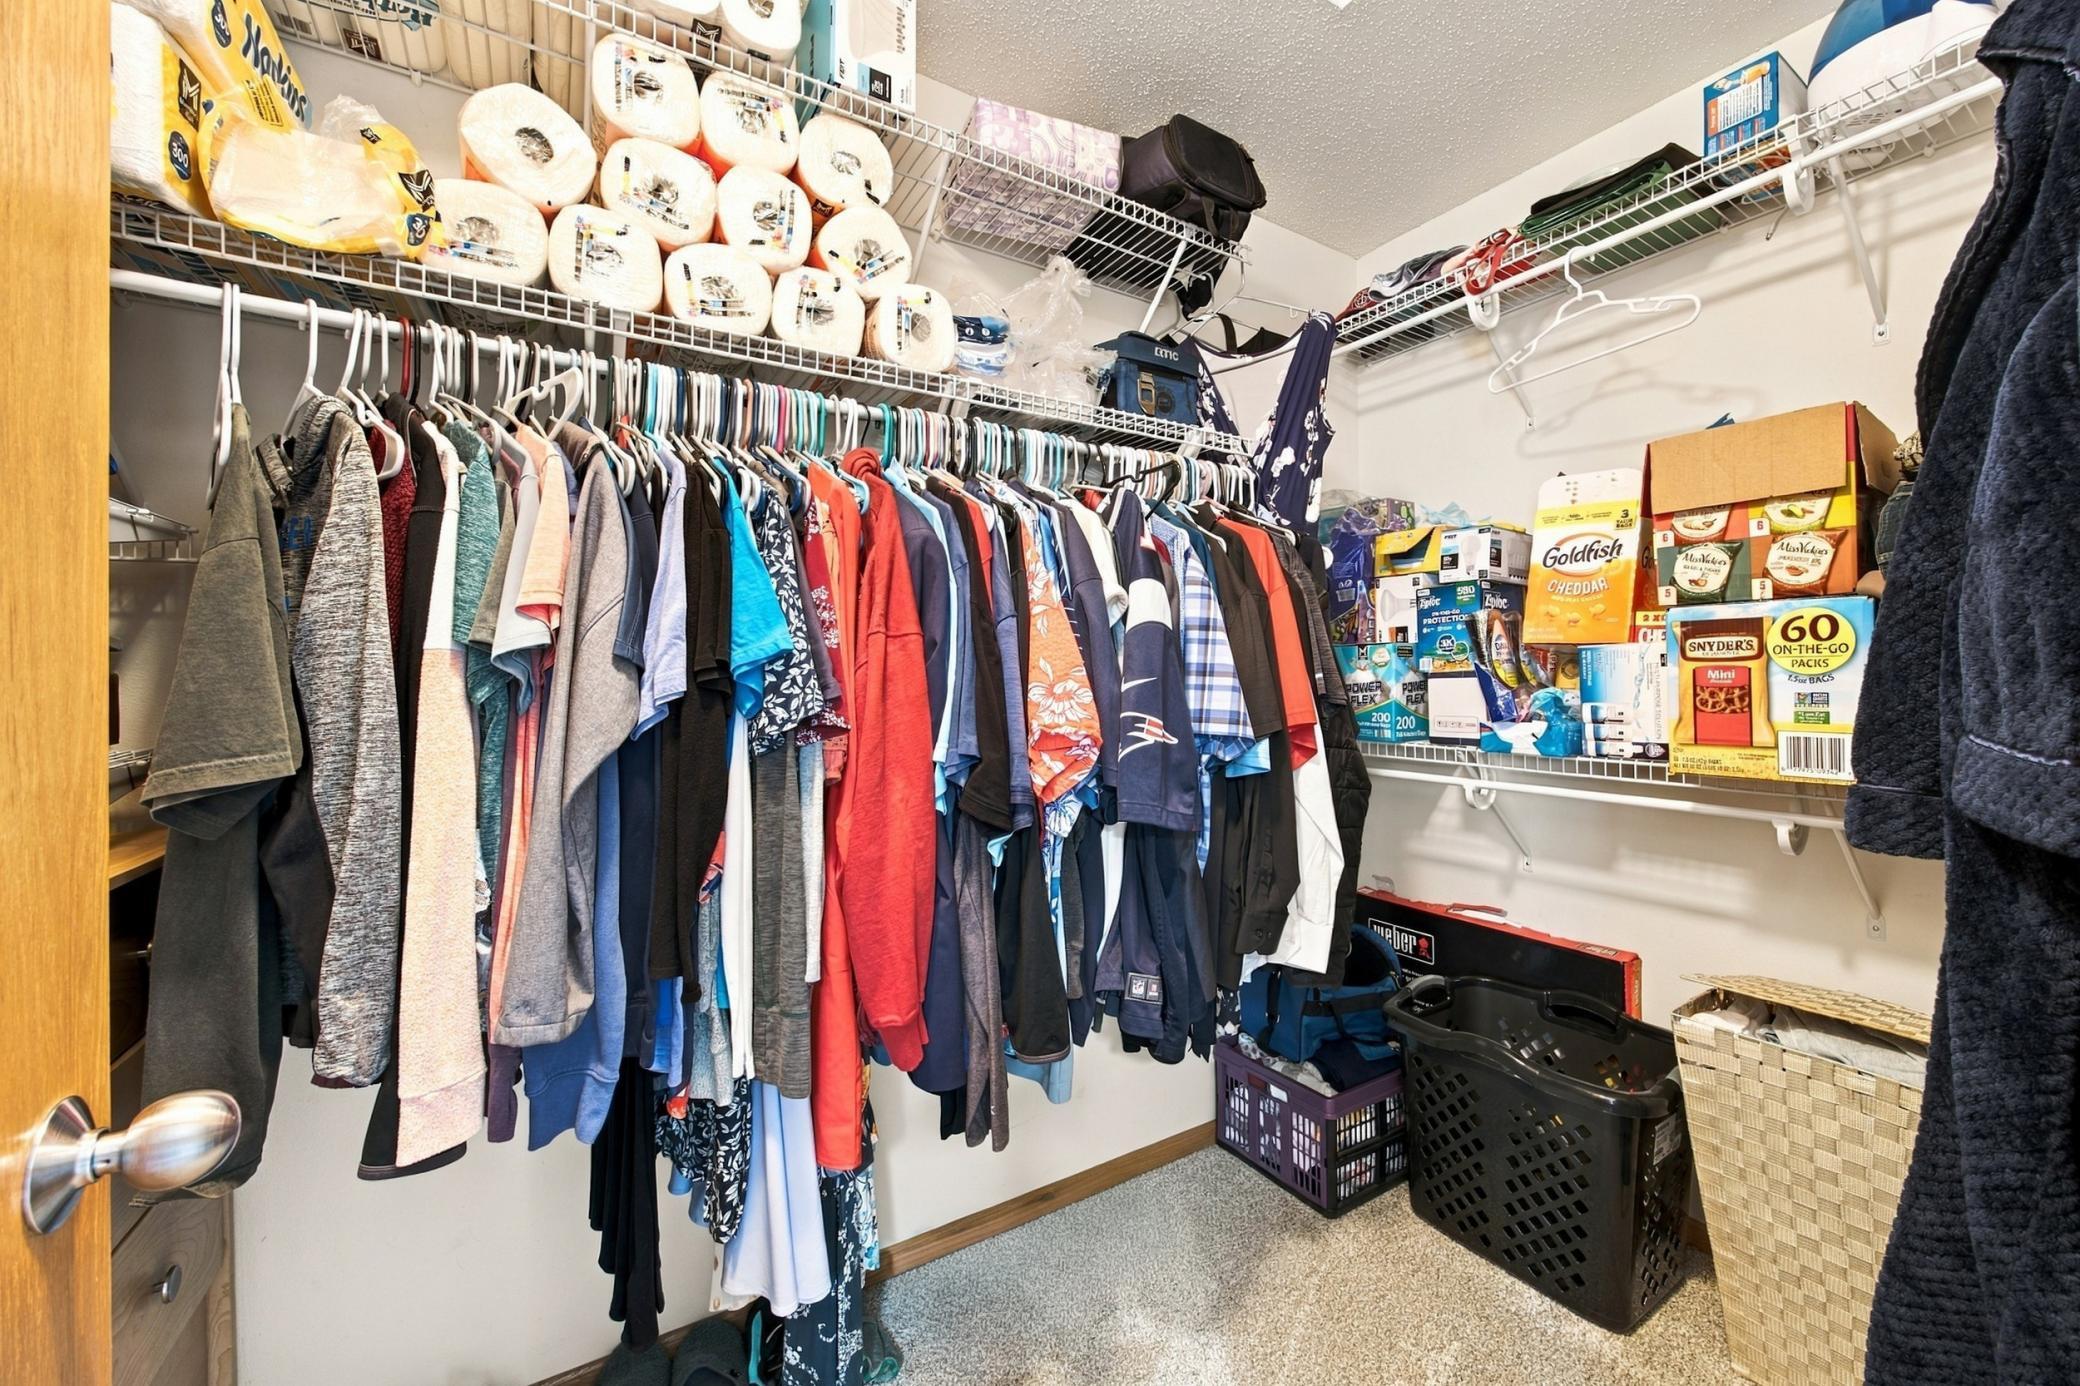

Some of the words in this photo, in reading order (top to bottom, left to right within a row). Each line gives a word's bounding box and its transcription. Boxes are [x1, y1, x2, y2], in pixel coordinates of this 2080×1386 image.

[171, 142, 190, 169] 300
[1620, 508, 1630, 518] 3
[1756, 520, 1764, 530] 6
[1662, 533, 1669, 543] 6
[1776, 541, 1800, 553] Miss
[1542, 538, 1623, 569] Goldfish
[1681, 552, 1702, 563] Miss
[1547, 577, 1609, 596] CHEDDAR
[1759, 580, 1766, 590] 5
[1664, 588, 1671, 598] 5
[1419, 597, 1441, 610] Ziploc
[1484, 593, 1509, 610] Ziploc
[1781, 613, 1840, 643] 60
[1688, 639, 1753, 652] SNYDER'S
[1772, 641, 1850, 655] ON-THE-GO
[1791, 658, 1829, 668] PACKS
[1707, 669, 1736, 679] Mini
[1808, 673, 1835, 684] BAGS
[1346, 681, 1382, 693] POWER
[1350, 693, 1376, 707] FLEX
[1405, 692, 1426, 705] FLEX
[1371, 712, 1391, 723] 200
[1395, 715, 1416, 730] 200
[1372, 923, 1417, 955] weber
